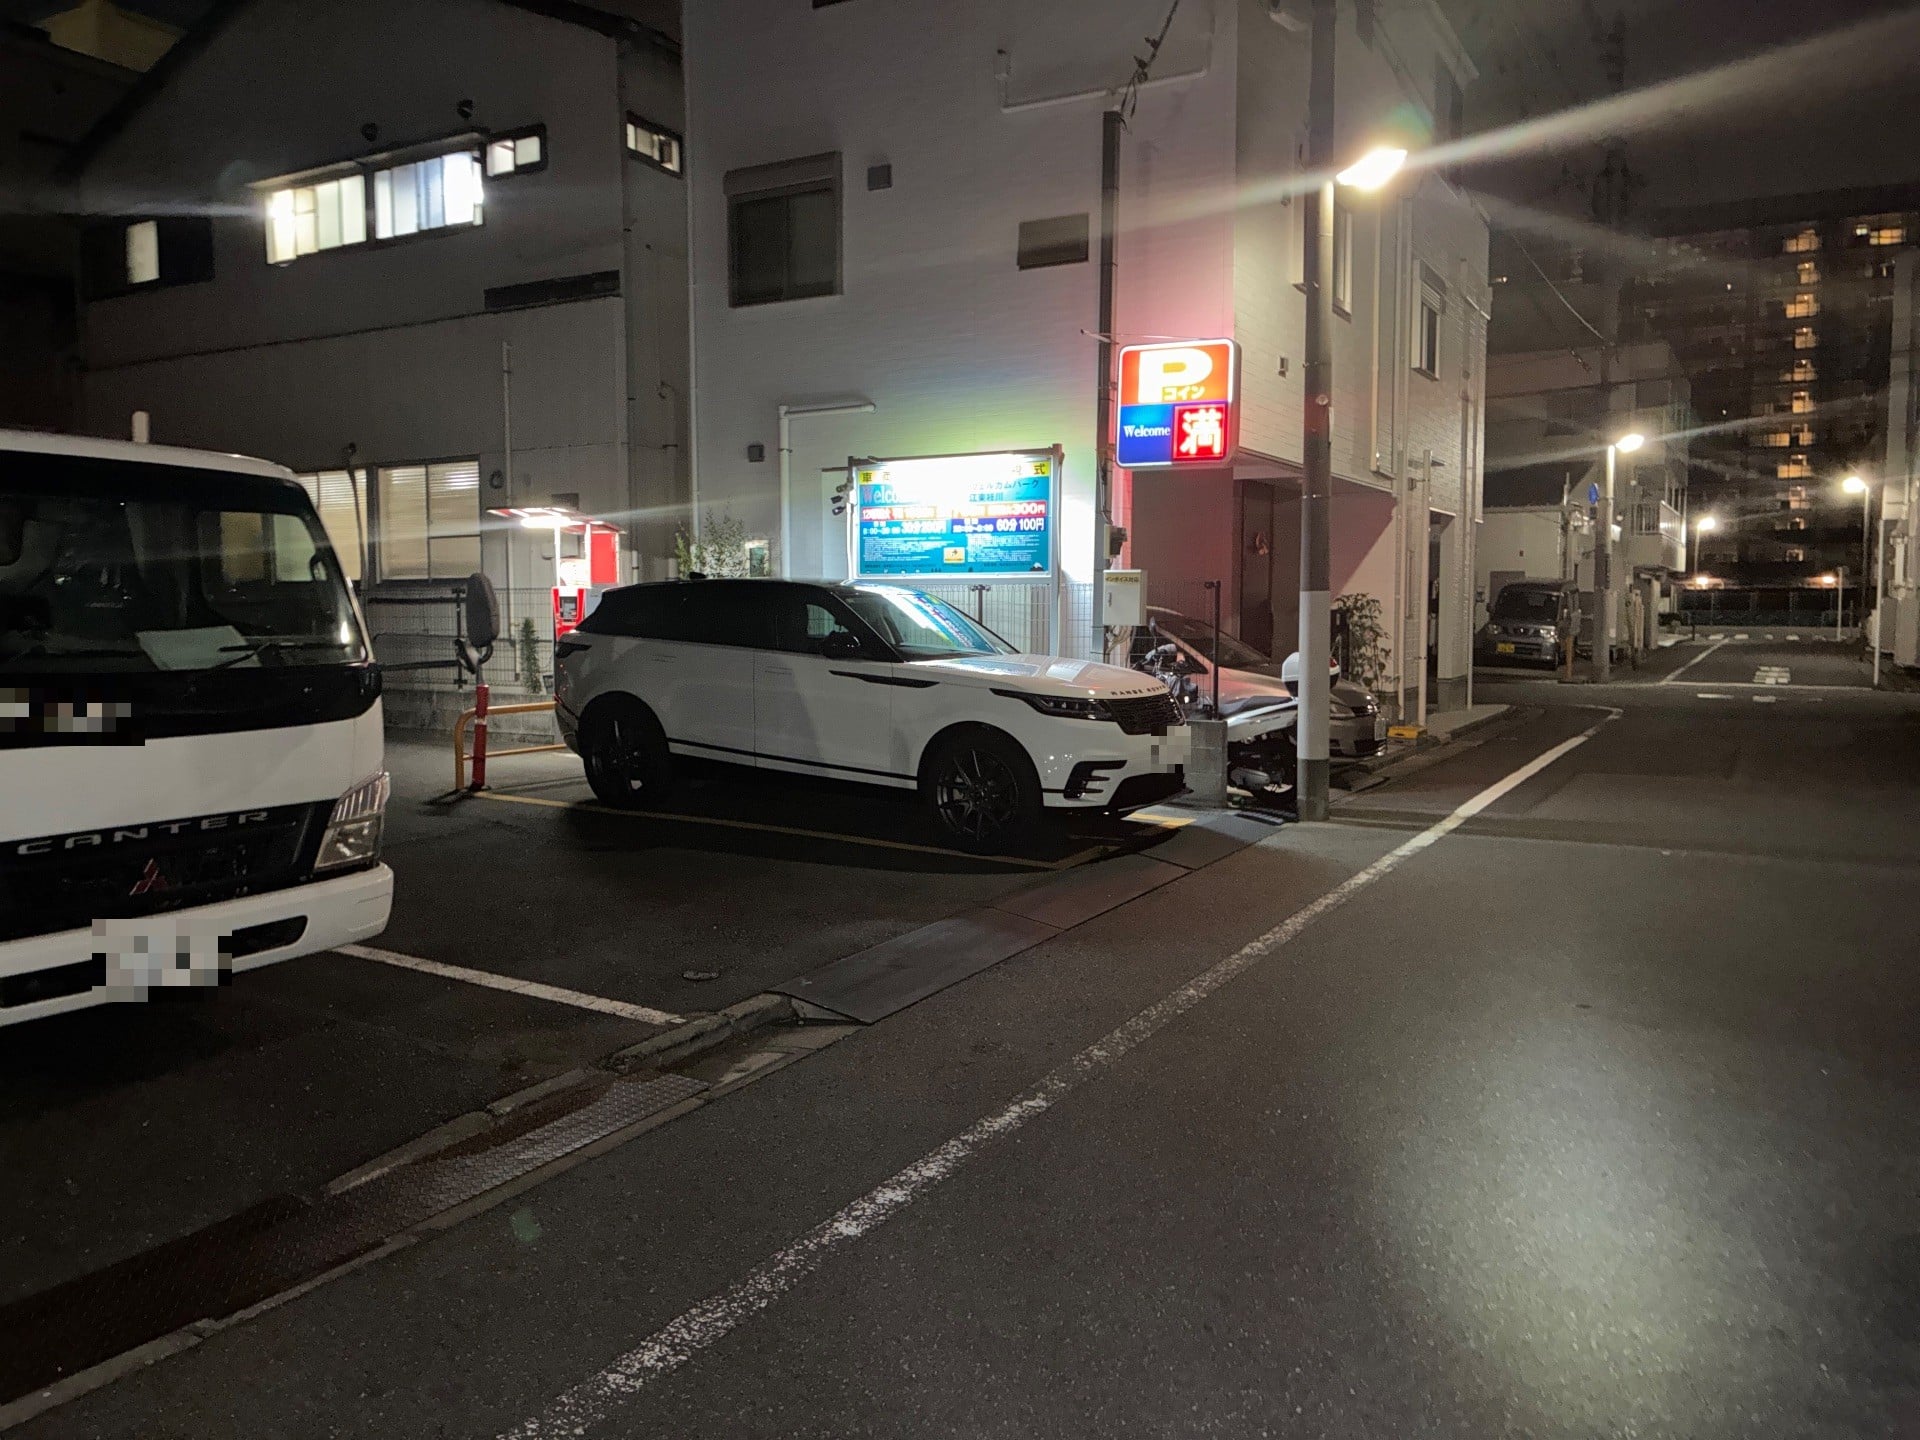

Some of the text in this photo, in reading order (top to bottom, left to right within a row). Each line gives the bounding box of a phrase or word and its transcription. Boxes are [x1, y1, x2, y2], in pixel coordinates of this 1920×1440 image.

[1138, 348, 1213, 403] P
[1164, 386, 1205, 401] コイン
[1123, 425, 1171, 438] Welcome
[1180, 408, 1222, 455] 満
[996, 518, 1017, 532] 60分
[1019, 518, 1044, 531] 100円
[16, 811, 269, 855] CANTER
